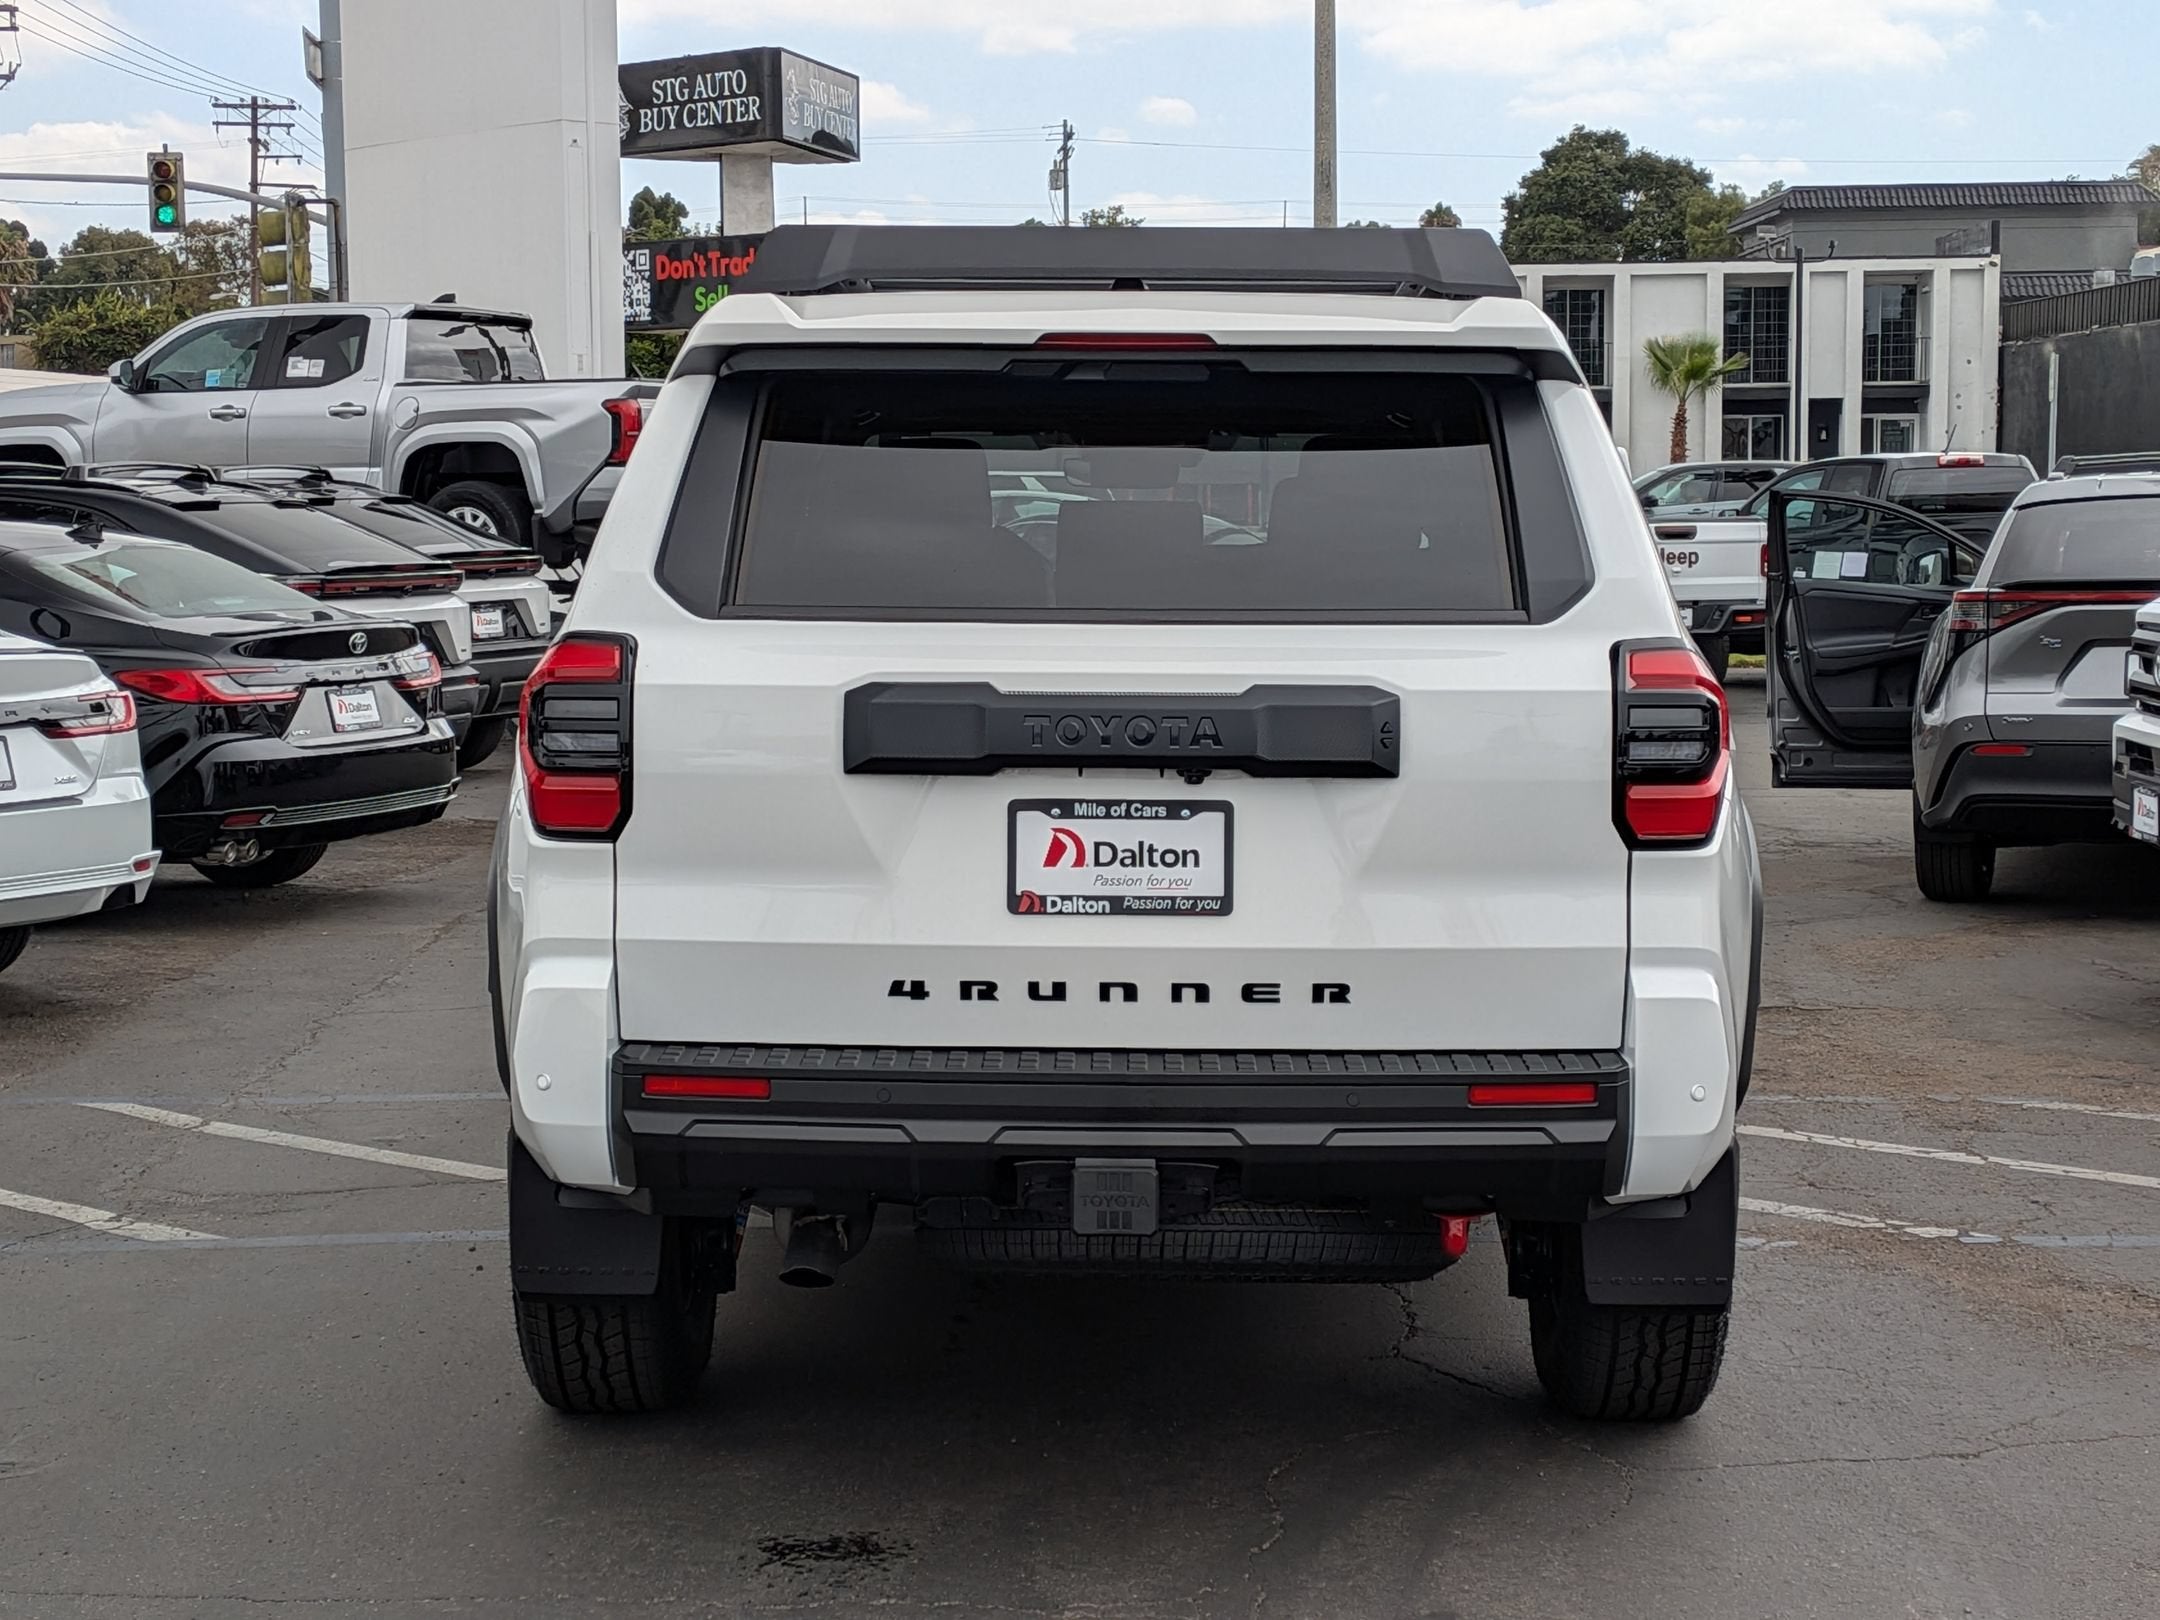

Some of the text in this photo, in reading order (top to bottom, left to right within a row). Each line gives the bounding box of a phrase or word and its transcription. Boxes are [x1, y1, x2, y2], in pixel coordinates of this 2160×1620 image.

[652, 69, 747, 105] STG AUTO
[809, 77, 853, 113] STG AUTO
[638, 95, 762, 134] BUY CENTER
[803, 102, 824, 131] BUY
[655, 252, 707, 281] Don't
[1023, 713, 1225, 750] TOYOTA
[1073, 802, 1167, 818] Mile of Cars
[1093, 840, 1200, 869] Dalton
[1093, 874, 1193, 889] Passion for you
[1046, 896, 1111, 914] Dalton
[1122, 897, 1222, 912] Passion for you
[887, 979, 1352, 1004] 4RUNNER
[1079, 1195, 1152, 1208] TOYOTA
